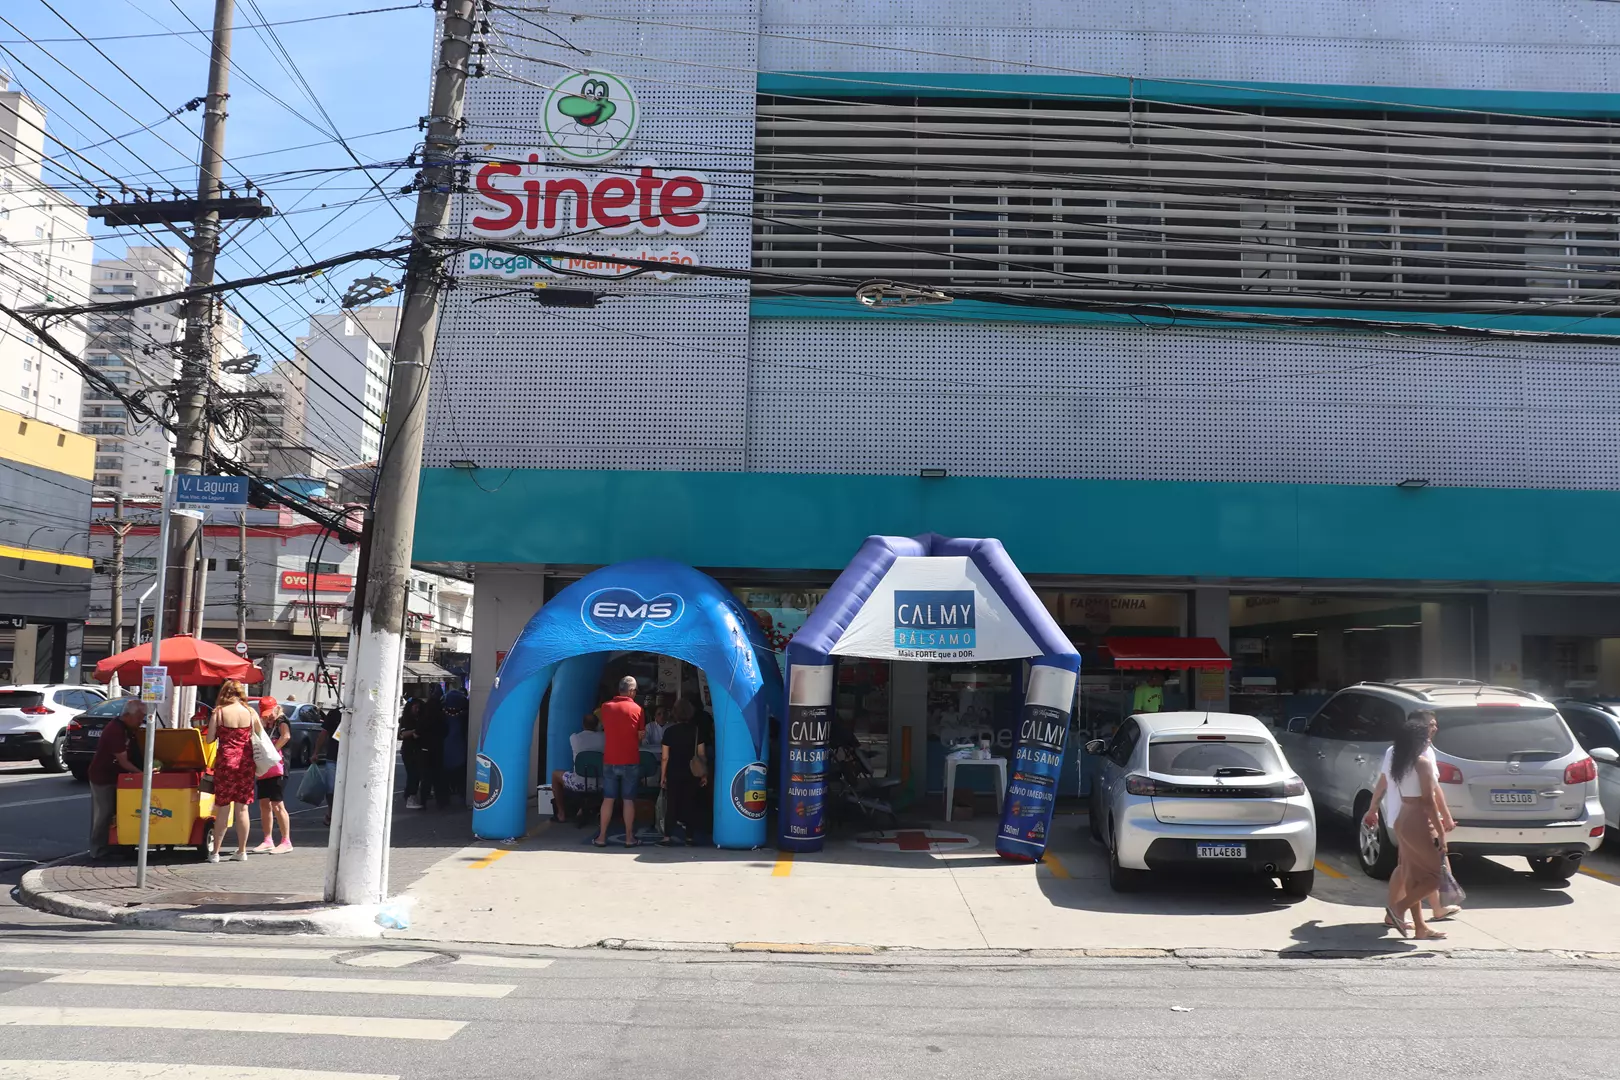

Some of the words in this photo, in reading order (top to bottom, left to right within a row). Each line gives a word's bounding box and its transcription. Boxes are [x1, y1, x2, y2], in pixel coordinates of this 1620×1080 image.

[472, 153, 704, 231] Sinete
[181, 478, 192, 492] V.
[196, 478, 240, 495] Laguna
[593, 602, 672, 619] EMS
[898, 604, 971, 625] CALMY
[899, 630, 971, 645] BÁLSAMO
[898, 650, 914, 658] Mais
[915, 650, 937, 658] FORTE
[938, 652, 951, 660] que
[958, 650, 975, 658] DOR.
[1021, 719, 1066, 746] CALMY
[752, 791, 759, 801] G
[790, 824, 808, 835] 150ml
[1003, 824, 1020, 836] 150ml
[1201, 847, 1242, 857] RTL4E88
